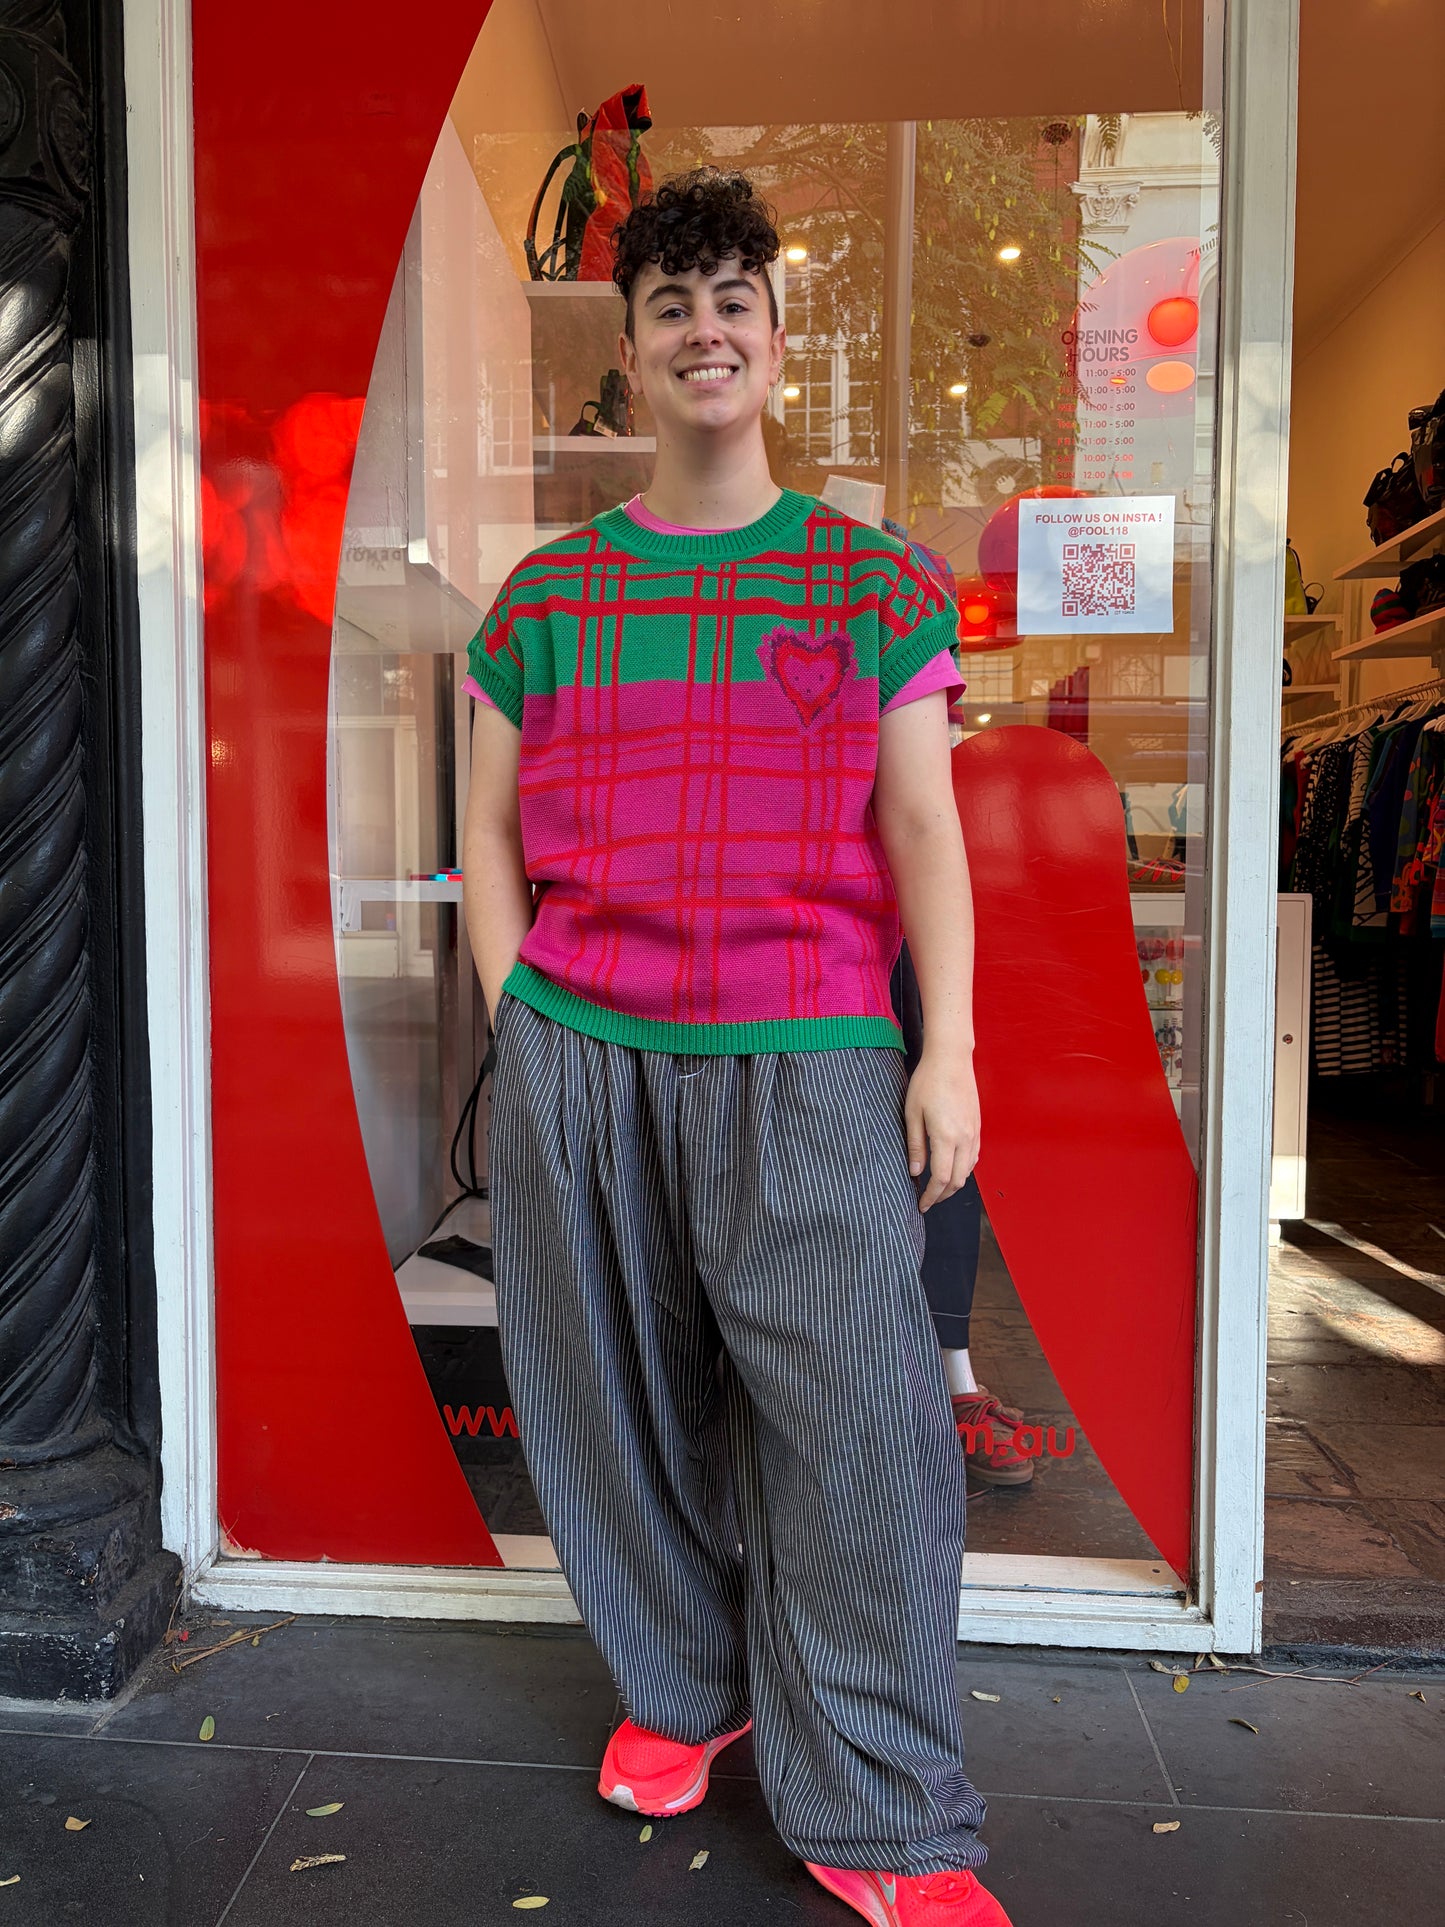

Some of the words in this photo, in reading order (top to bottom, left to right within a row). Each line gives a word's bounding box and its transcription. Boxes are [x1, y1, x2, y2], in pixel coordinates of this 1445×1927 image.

[1061, 329, 1138, 345] OPENING
[1069, 346, 1130, 362] HOURS
[1059, 369, 1078, 377] MON
[1086, 369, 1108, 377] 11:00
[1116, 368, 1136, 376] 5:00
[1086, 386, 1108, 394] 11:00
[1116, 386, 1136, 394] 5:00
[1115, 403, 1135, 411] 5:00
[1084, 420, 1106, 428] 11:00
[1115, 419, 1135, 428] 5:00
[1083, 437, 1106, 445] 11:00
[1115, 437, 1134, 445] 5:00
[1083, 454, 1106, 462] 10:00
[1056, 471, 1075, 479] SUN
[1035, 514, 1083, 524] FOLLOW
[1085, 513, 1100, 523] US
[1103, 513, 1120, 523] ON
[1122, 513, 1156, 523] INSTA
[1068, 526, 1129, 538] @FOOL118
